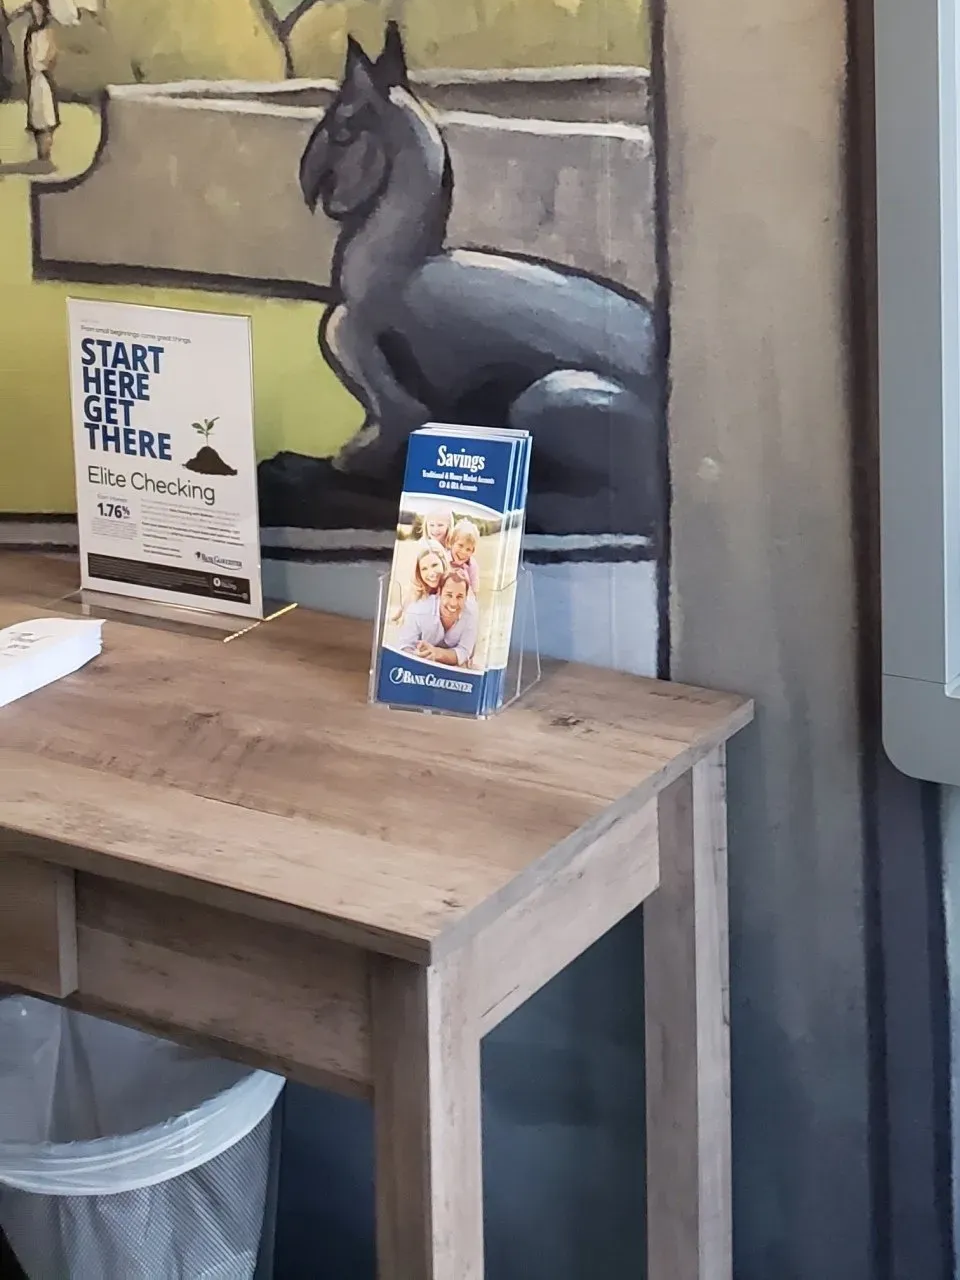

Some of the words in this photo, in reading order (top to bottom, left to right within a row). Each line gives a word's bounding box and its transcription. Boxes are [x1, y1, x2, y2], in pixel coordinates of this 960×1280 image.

[81, 338, 164, 374] START
[83, 366, 150, 401] HERE
[84, 394, 134, 427] GET
[84, 422, 172, 461] THERE
[436, 445, 486, 473] Savings
[88, 465, 126, 488] Elite
[131, 472, 215, 506] Checking
[97, 502, 130, 519] 1.76%
